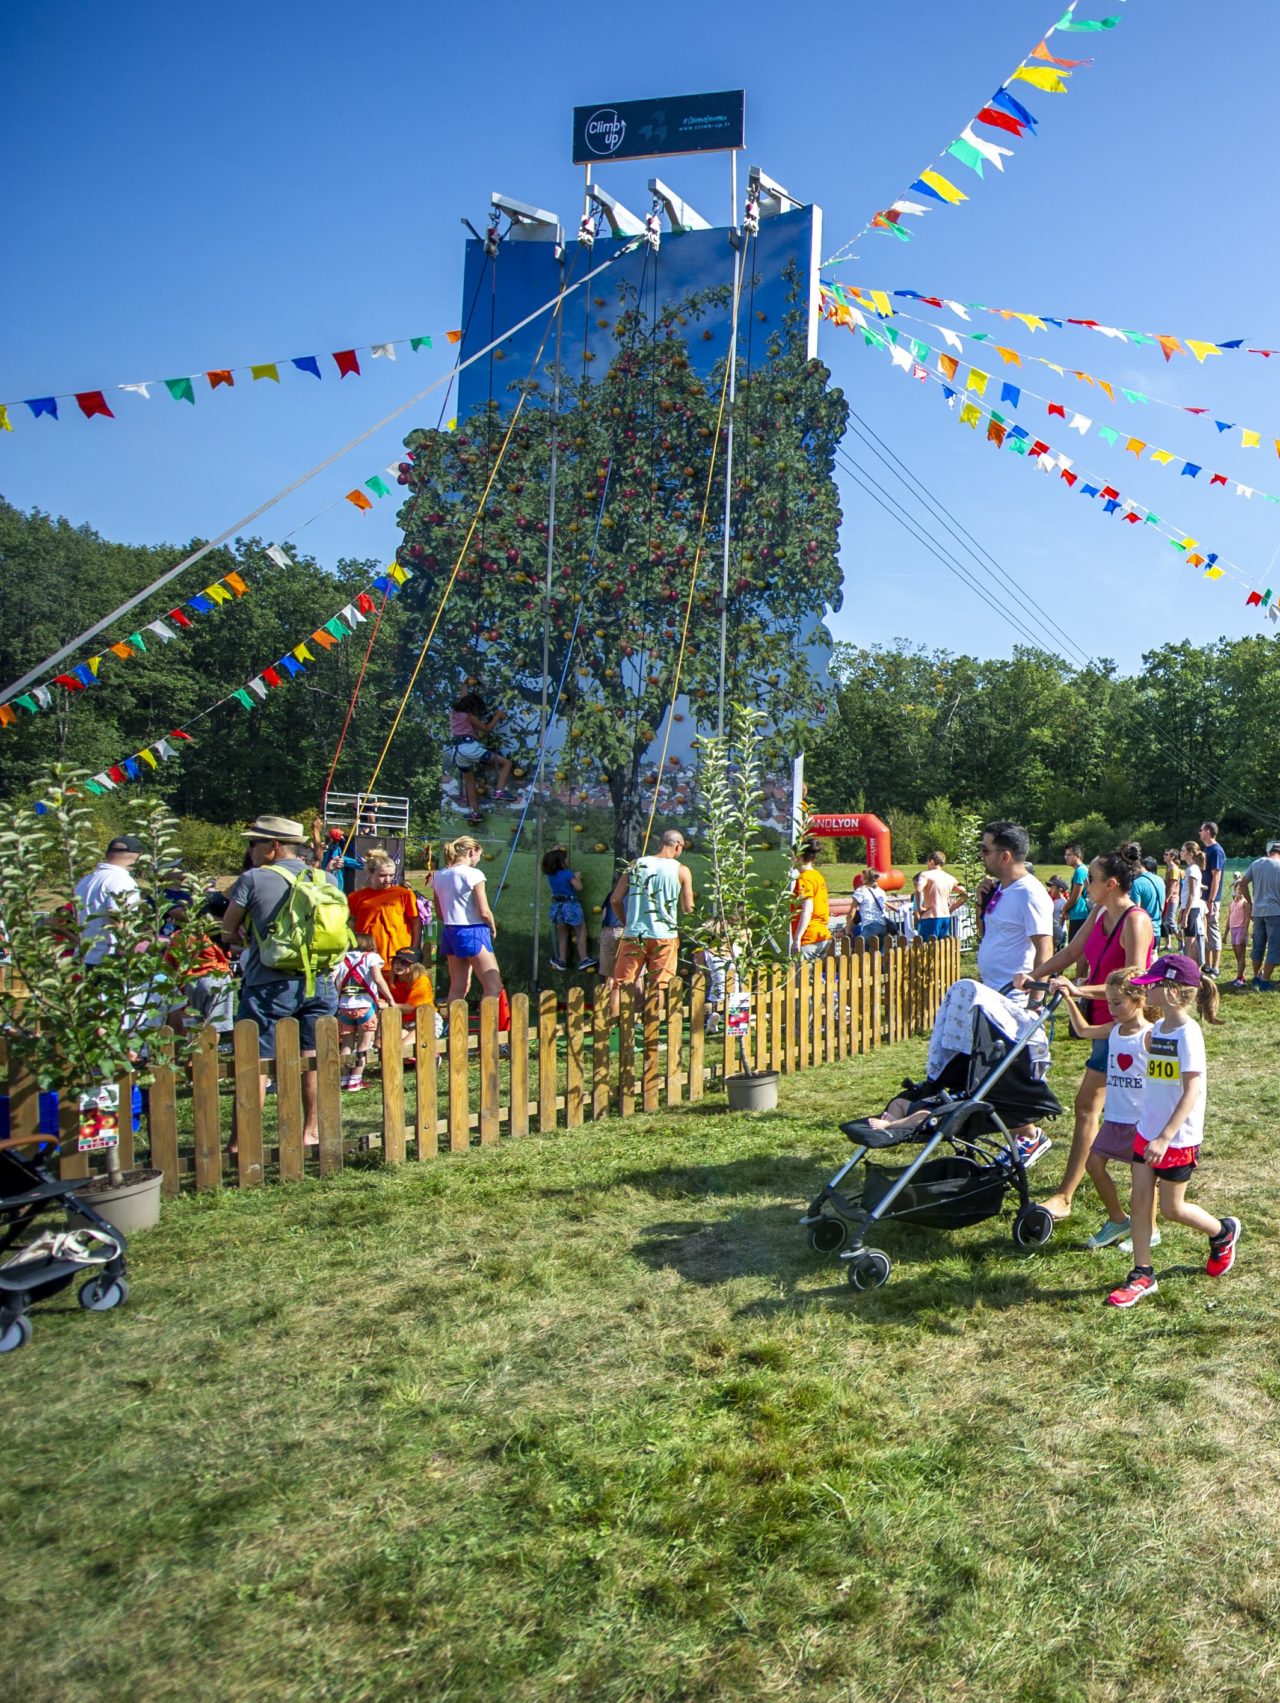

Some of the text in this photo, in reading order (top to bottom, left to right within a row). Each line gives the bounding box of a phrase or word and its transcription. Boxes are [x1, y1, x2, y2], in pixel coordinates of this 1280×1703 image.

[589, 115, 621, 134] Climb
[810, 818, 859, 829] ANDLYON
[1110, 1054, 1115, 1069] I
[1149, 1060, 1174, 1078] 910
